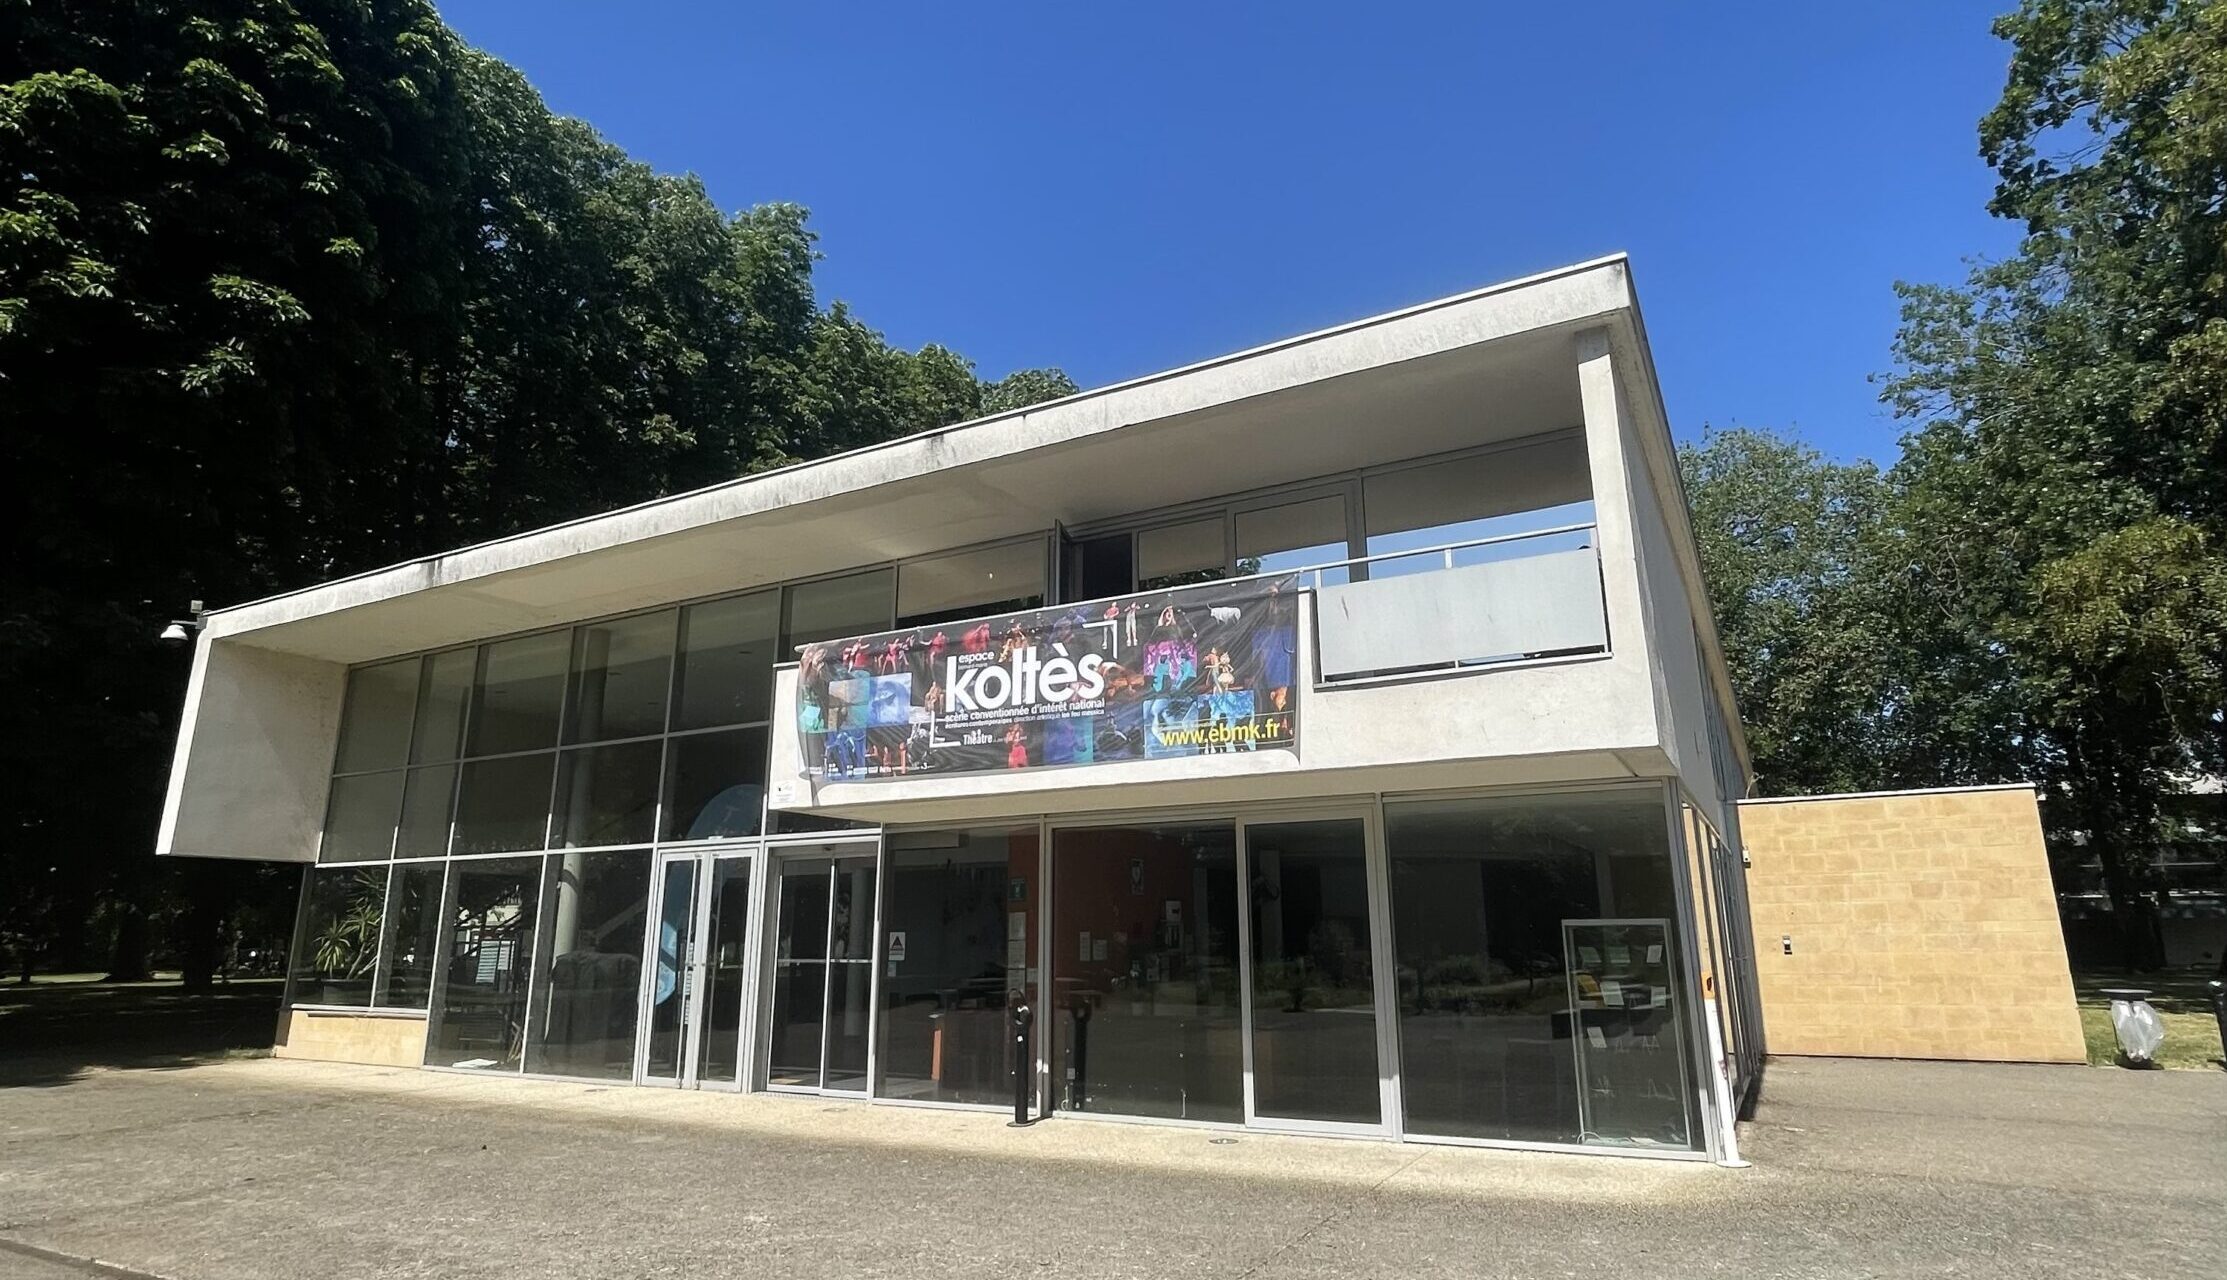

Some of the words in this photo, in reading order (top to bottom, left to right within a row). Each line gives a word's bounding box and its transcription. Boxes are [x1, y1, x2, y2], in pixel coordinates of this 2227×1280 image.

[959, 651, 995, 664] espace
[946, 643, 1105, 713] koltès
[945, 711, 969, 723] scène
[970, 706, 1030, 720] conventionnée
[1031, 702, 1067, 715] d'intérêt
[1069, 697, 1105, 711] national
[963, 729, 993, 746] Théâtre
[1162, 718, 1281, 746] www.ebmk.fr
